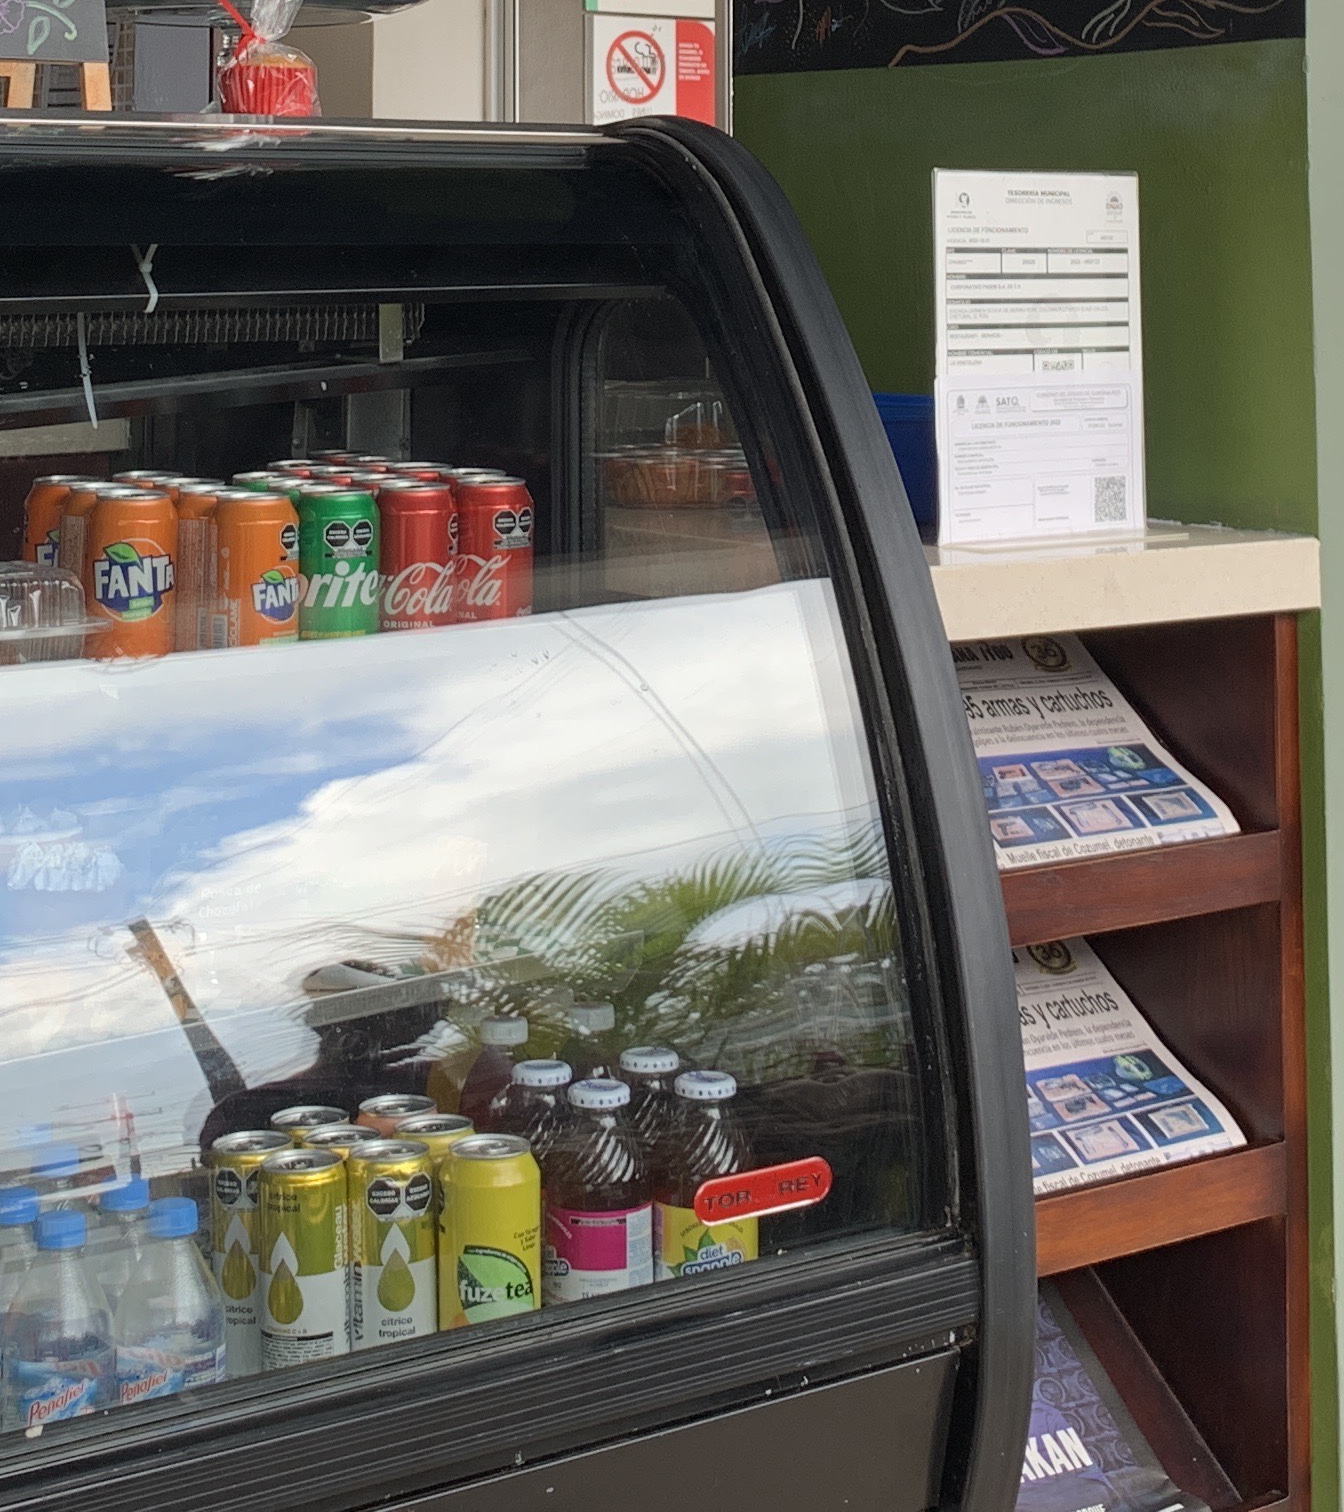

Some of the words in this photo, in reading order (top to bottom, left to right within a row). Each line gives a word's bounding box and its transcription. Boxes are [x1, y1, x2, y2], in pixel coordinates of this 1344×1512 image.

[93, 553, 175, 600] FANTA
[383, 619, 435, 630] ORIGINAL
[981, 694, 1031, 718] armas
[1026, 695, 1045, 719] y
[1040, 686, 1114, 714] cartuchos
[1061, 845, 1074, 857] de
[1031, 1003, 1051, 1029] y
[1046, 988, 1119, 1021] cartuchos
[777, 1172, 824, 1198] REY
[700, 1245, 723, 1261] diet
[378, 1326, 416, 1338] tropical
